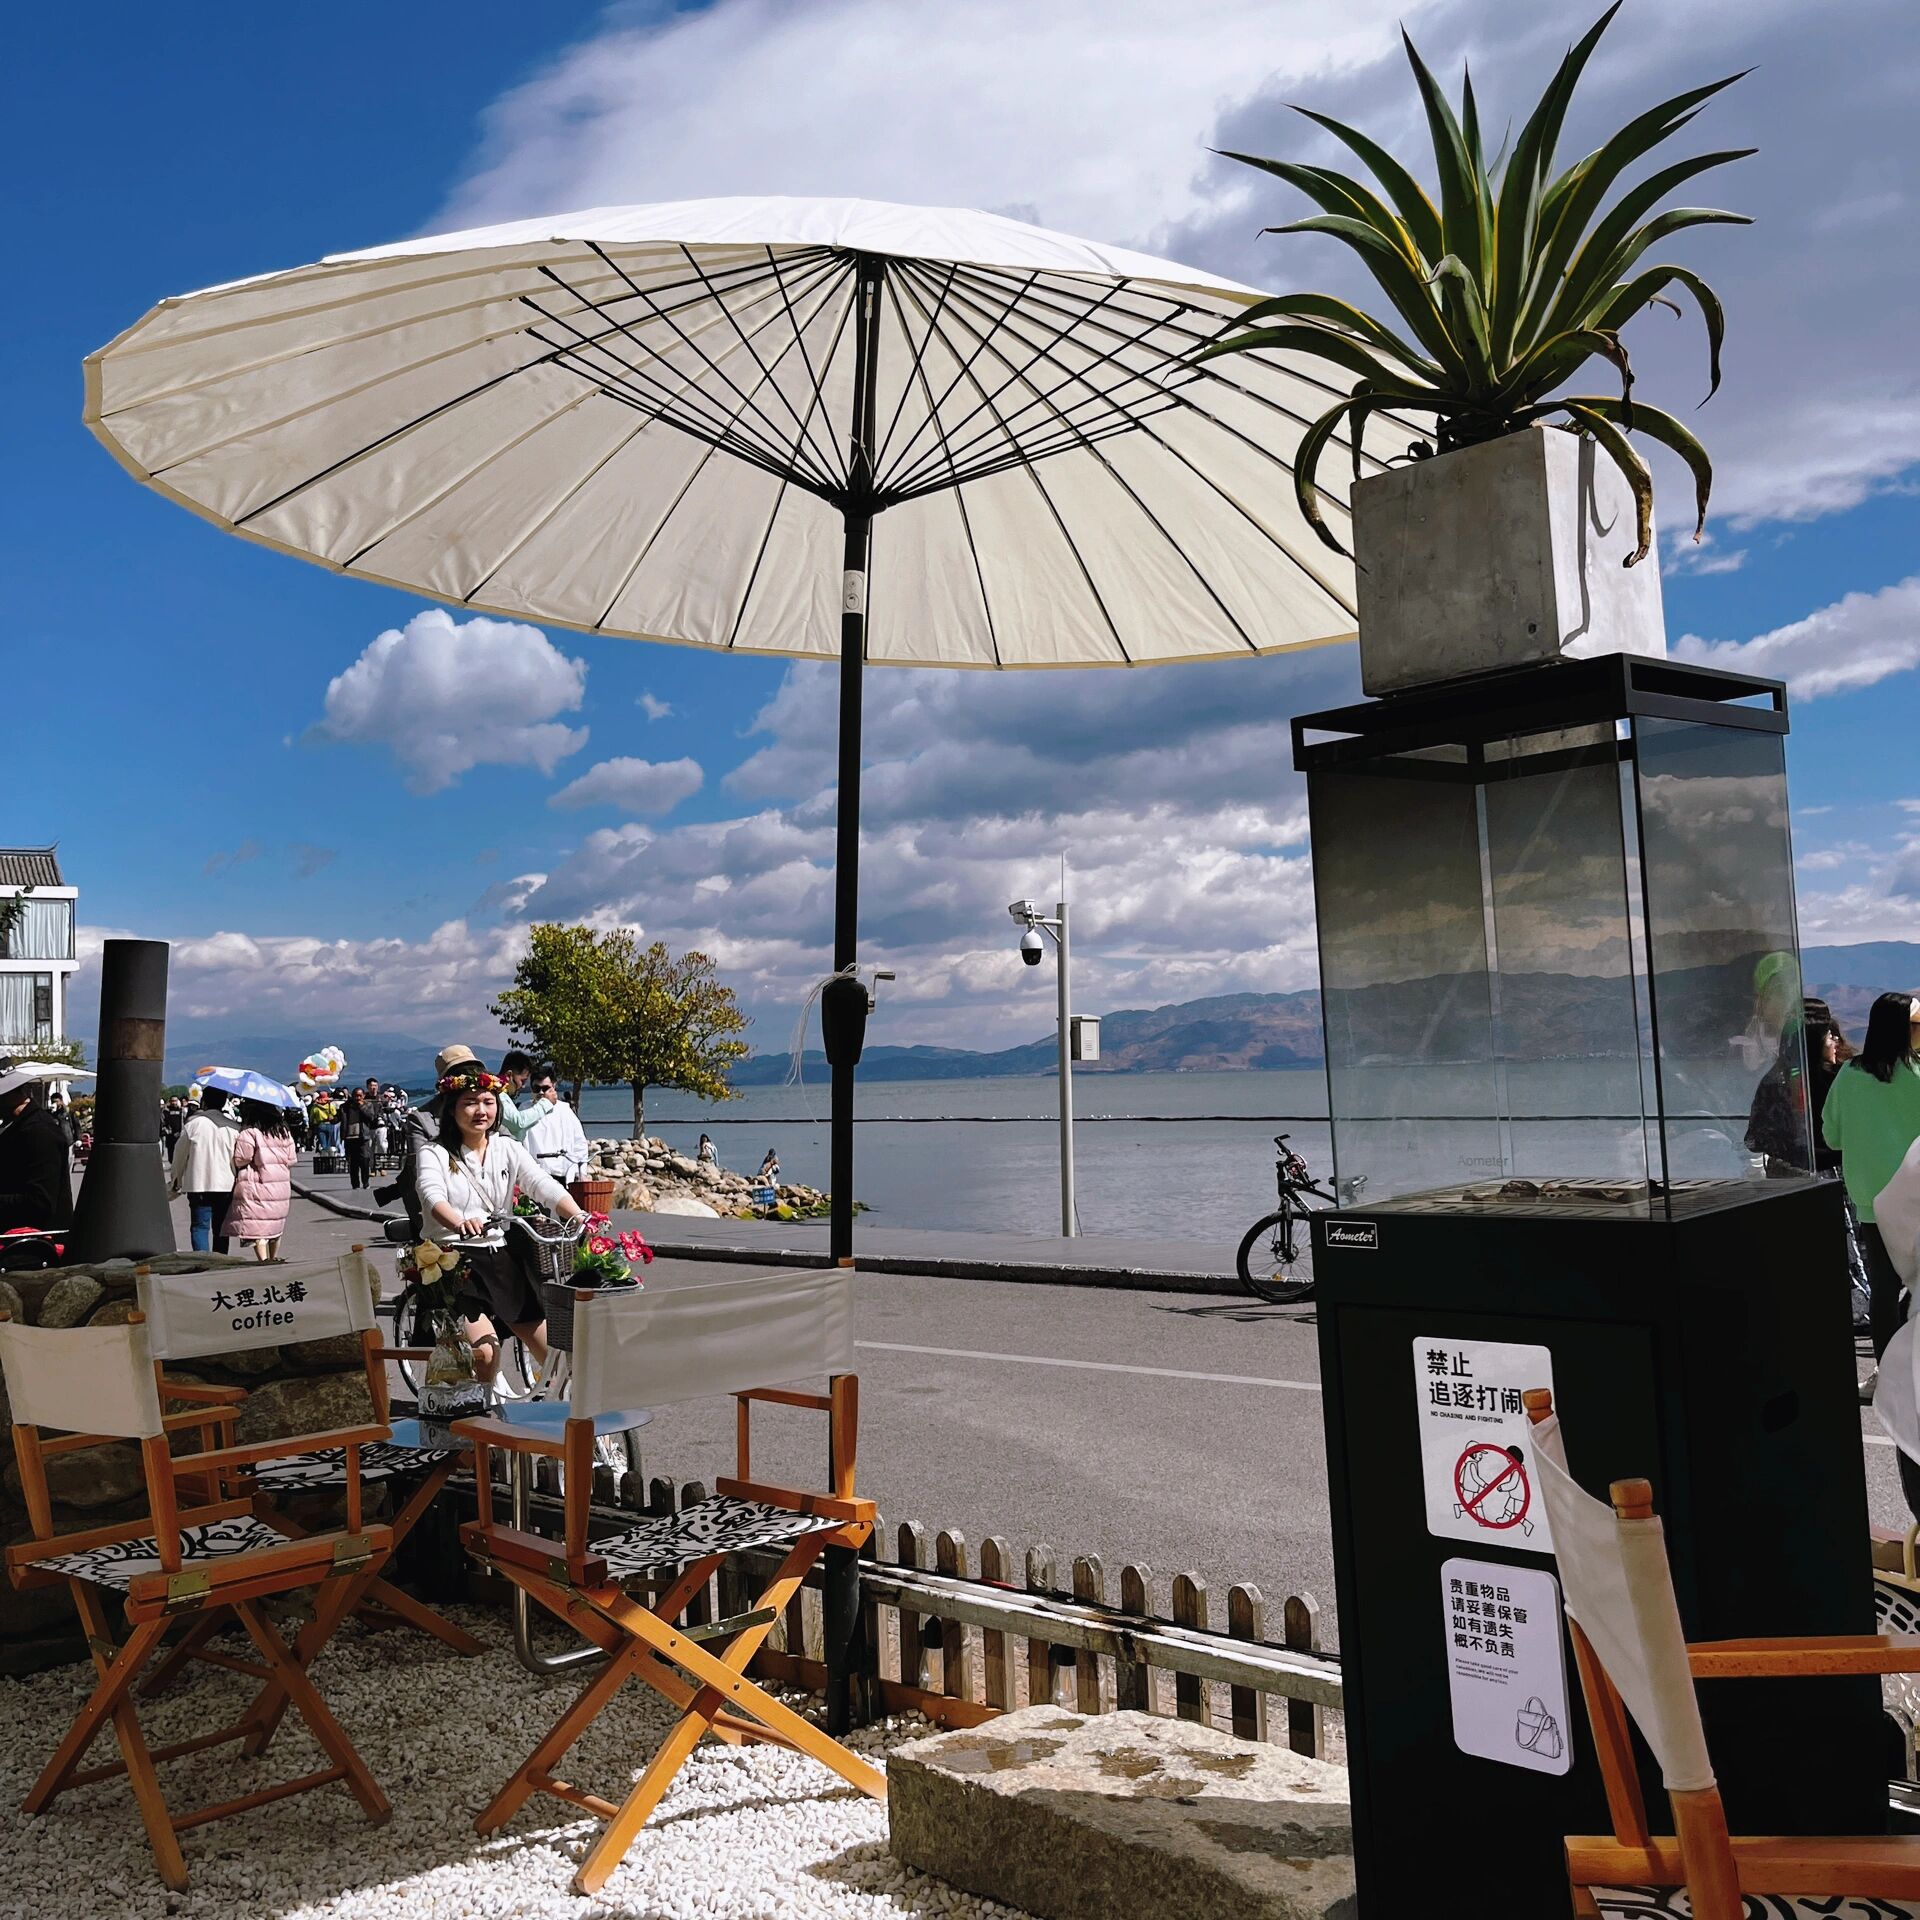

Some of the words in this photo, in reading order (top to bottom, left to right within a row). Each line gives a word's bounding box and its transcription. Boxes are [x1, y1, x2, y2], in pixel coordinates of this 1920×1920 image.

[1457, 1155, 1509, 1168] Aometer
[1328, 1228, 1375, 1243] Aometer
[231, 1310, 294, 1331] coffee
[1427, 1349, 1472, 1377] 禁止
[427, 1393, 435, 1410] 6
[1429, 1381, 1523, 1414] 追逐打闹
[1440, 1411, 1463, 1420] CHASING
[1478, 1416, 1503, 1424] FIGHTING
[1450, 1579, 1510, 1603] 贵重物品
[1451, 1596, 1528, 1624] 请妥善保管
[1452, 1614, 1514, 1640] 如有遗失
[1454, 1632, 1515, 1659] 概不负责
